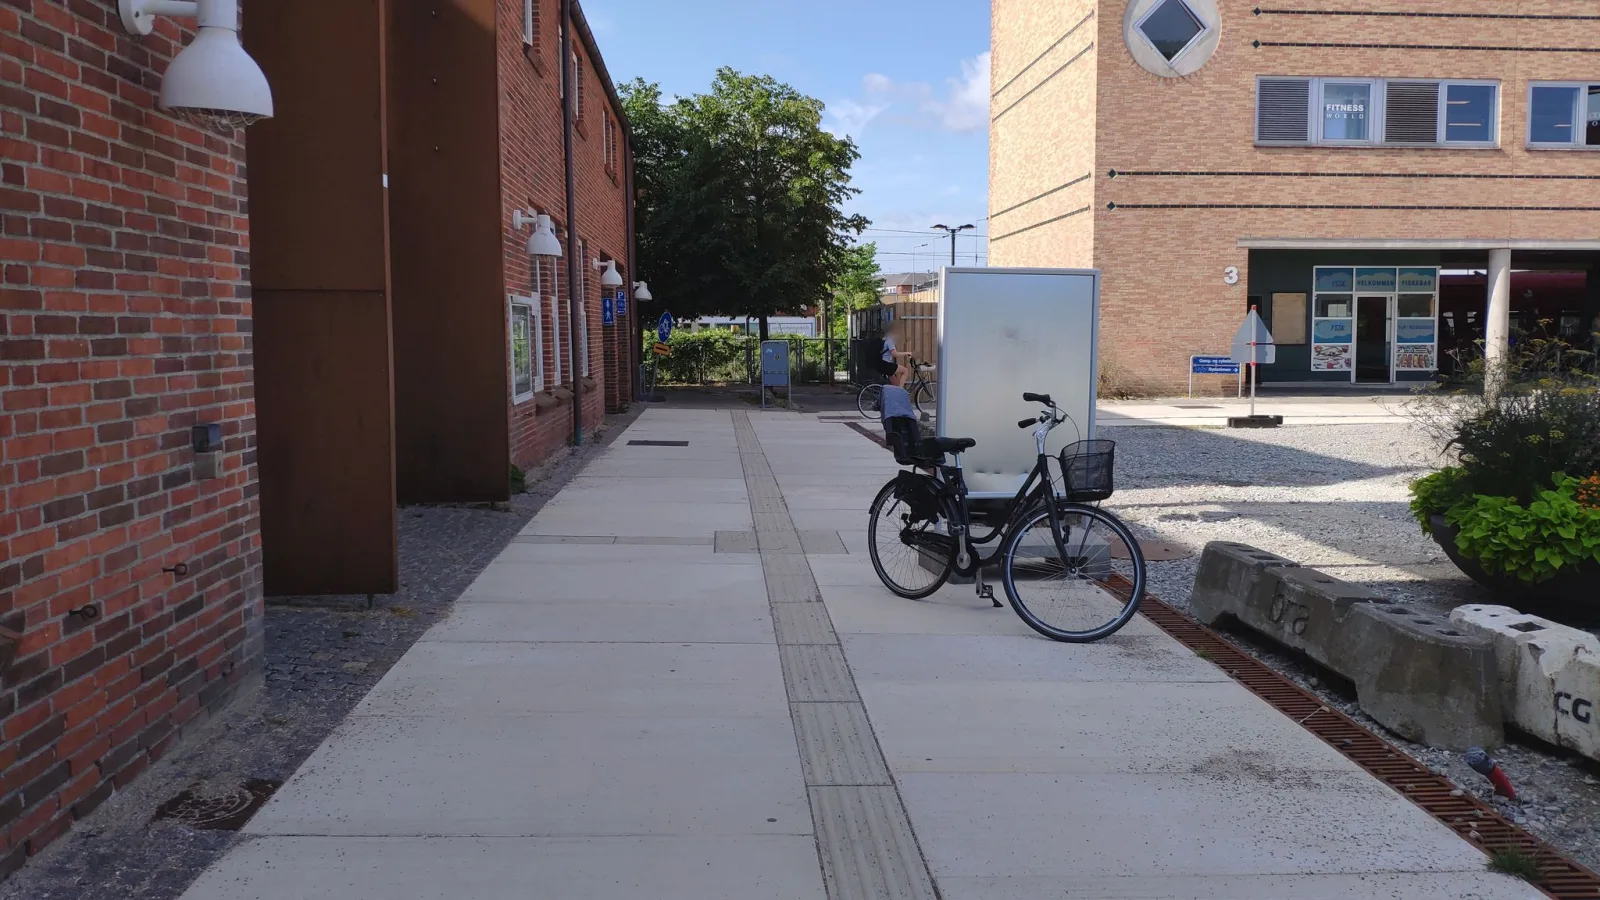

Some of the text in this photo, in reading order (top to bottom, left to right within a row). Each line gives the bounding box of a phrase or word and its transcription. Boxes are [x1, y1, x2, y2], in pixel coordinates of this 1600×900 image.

[1326, 104, 1364, 112] FITNESS
[1224, 266, 1239, 284] 3
[617, 291, 624, 299] P
